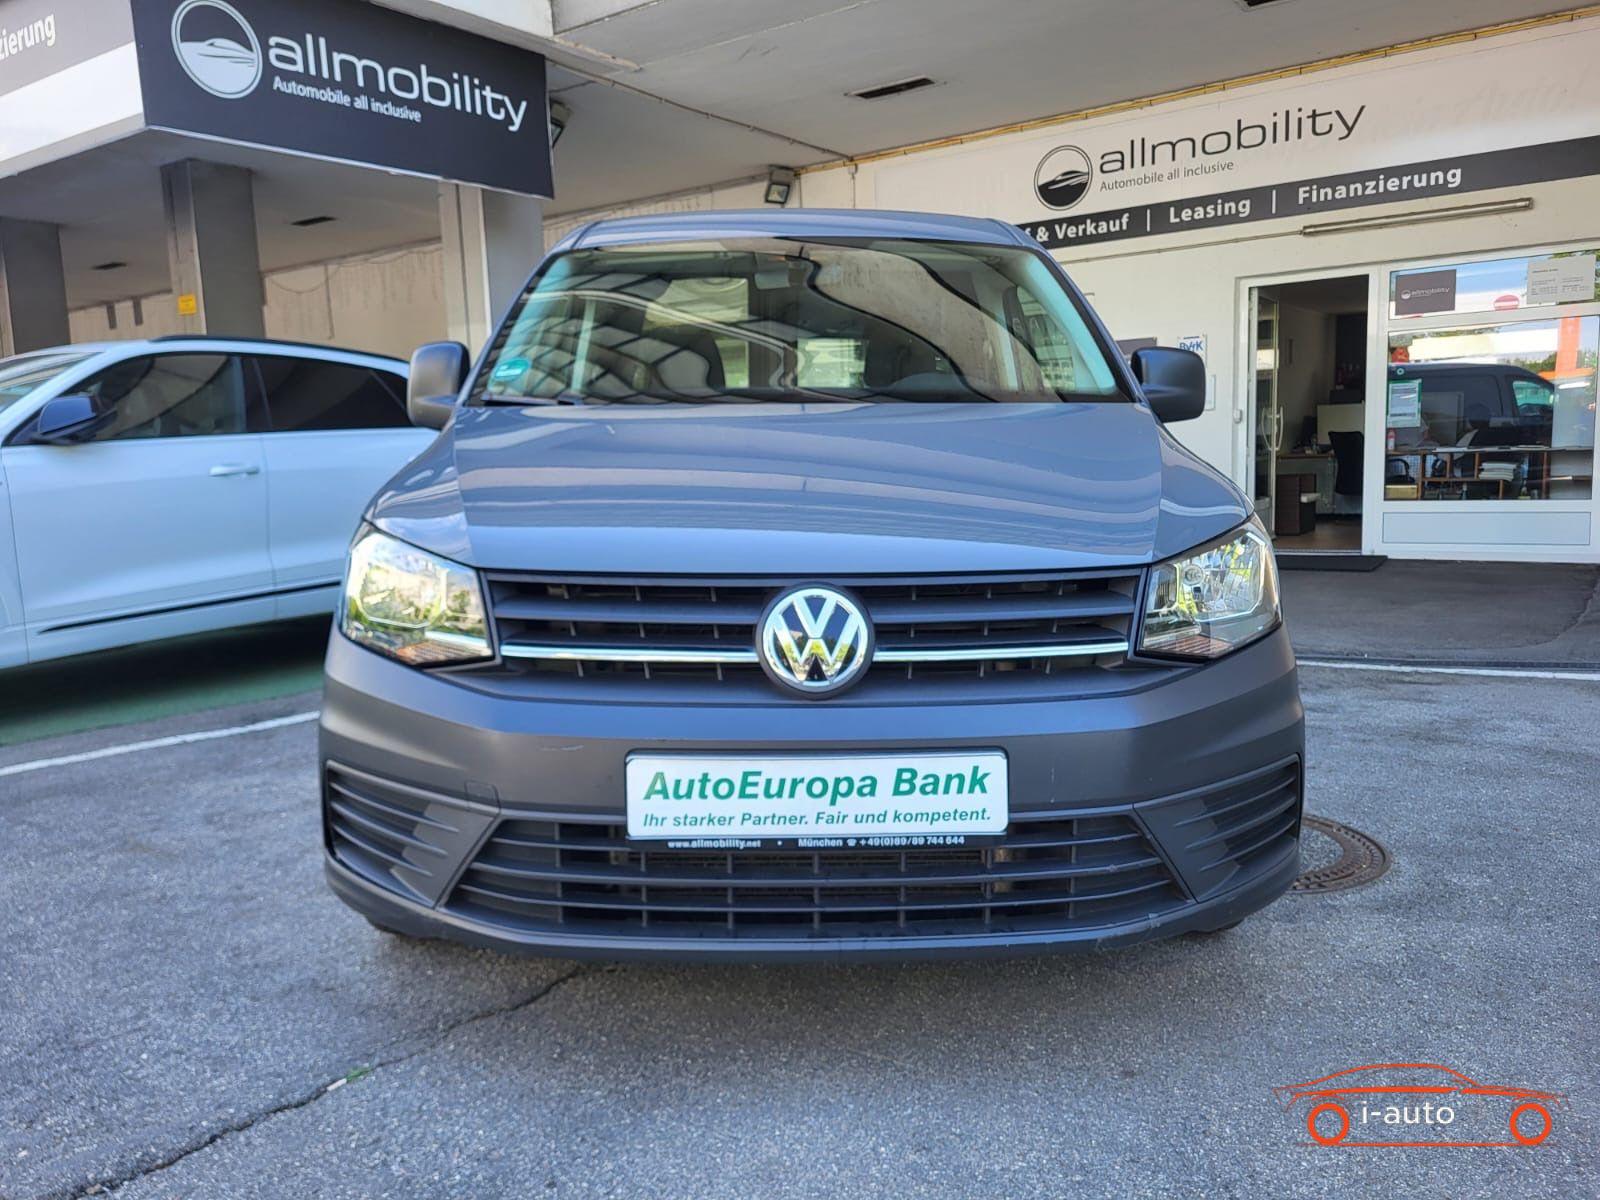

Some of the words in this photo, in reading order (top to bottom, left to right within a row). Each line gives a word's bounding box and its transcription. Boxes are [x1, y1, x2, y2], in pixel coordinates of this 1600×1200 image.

[268, 33, 527, 132] allmobility
[272, 75, 351, 106] Automobile
[353, 94, 369, 111] all
[371, 98, 422, 123] inclusive
[1099, 105, 1366, 174] allmobility
[1099, 170, 1164, 192] Automobile
[1167, 168, 1181, 181] all
[1183, 160, 1234, 177] inclusive
[1036, 225, 1049, 242] &
[1054, 213, 1130, 240] Verkauf
[1169, 198, 1251, 224] Leasing
[1298, 168, 1462, 205] Finanzierung
[643, 770, 878, 806] AutoEuropa
[891, 765, 992, 797] Bank
[643, 813, 667, 827] Ihr
[672, 812, 735, 827] starker
[740, 812, 808, 827] Partner.
[815, 810, 848, 825] Fair
[854, 810, 887, 824] und
[892, 807, 991, 826] kompetent.
[667, 838, 761, 850] www.allmobility.net
[798, 836, 843, 848] München
